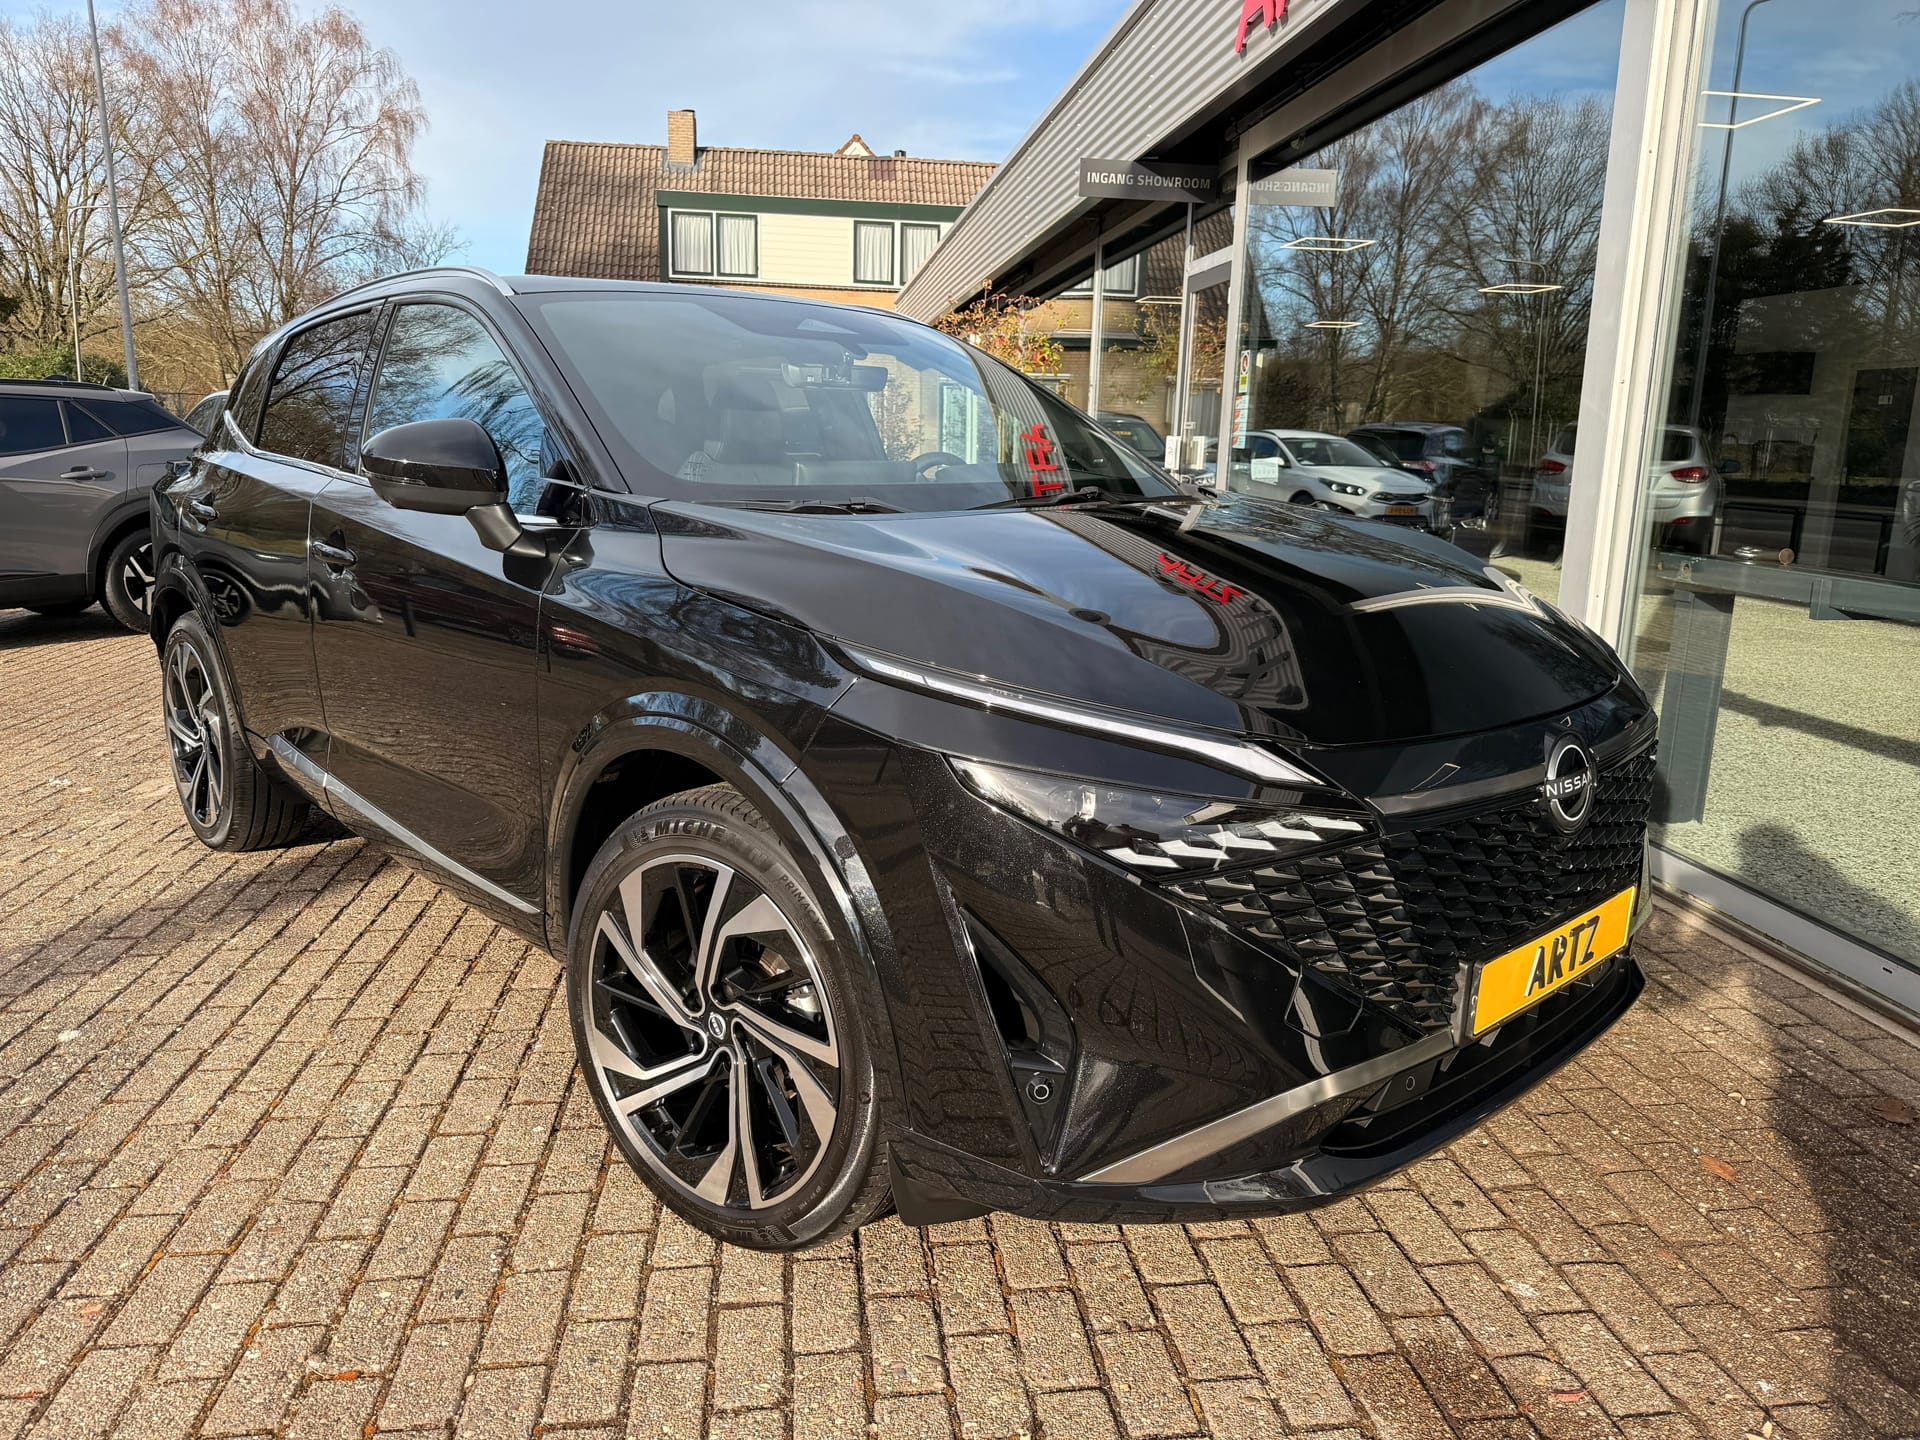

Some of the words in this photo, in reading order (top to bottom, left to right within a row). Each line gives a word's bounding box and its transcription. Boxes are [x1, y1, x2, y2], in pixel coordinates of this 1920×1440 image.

[1086, 171, 1135, 186] INGANG
[1137, 174, 1211, 190] SHOWROOM
[1545, 770, 1593, 798] NISSAN
[1523, 914, 1601, 998] ARTZ
